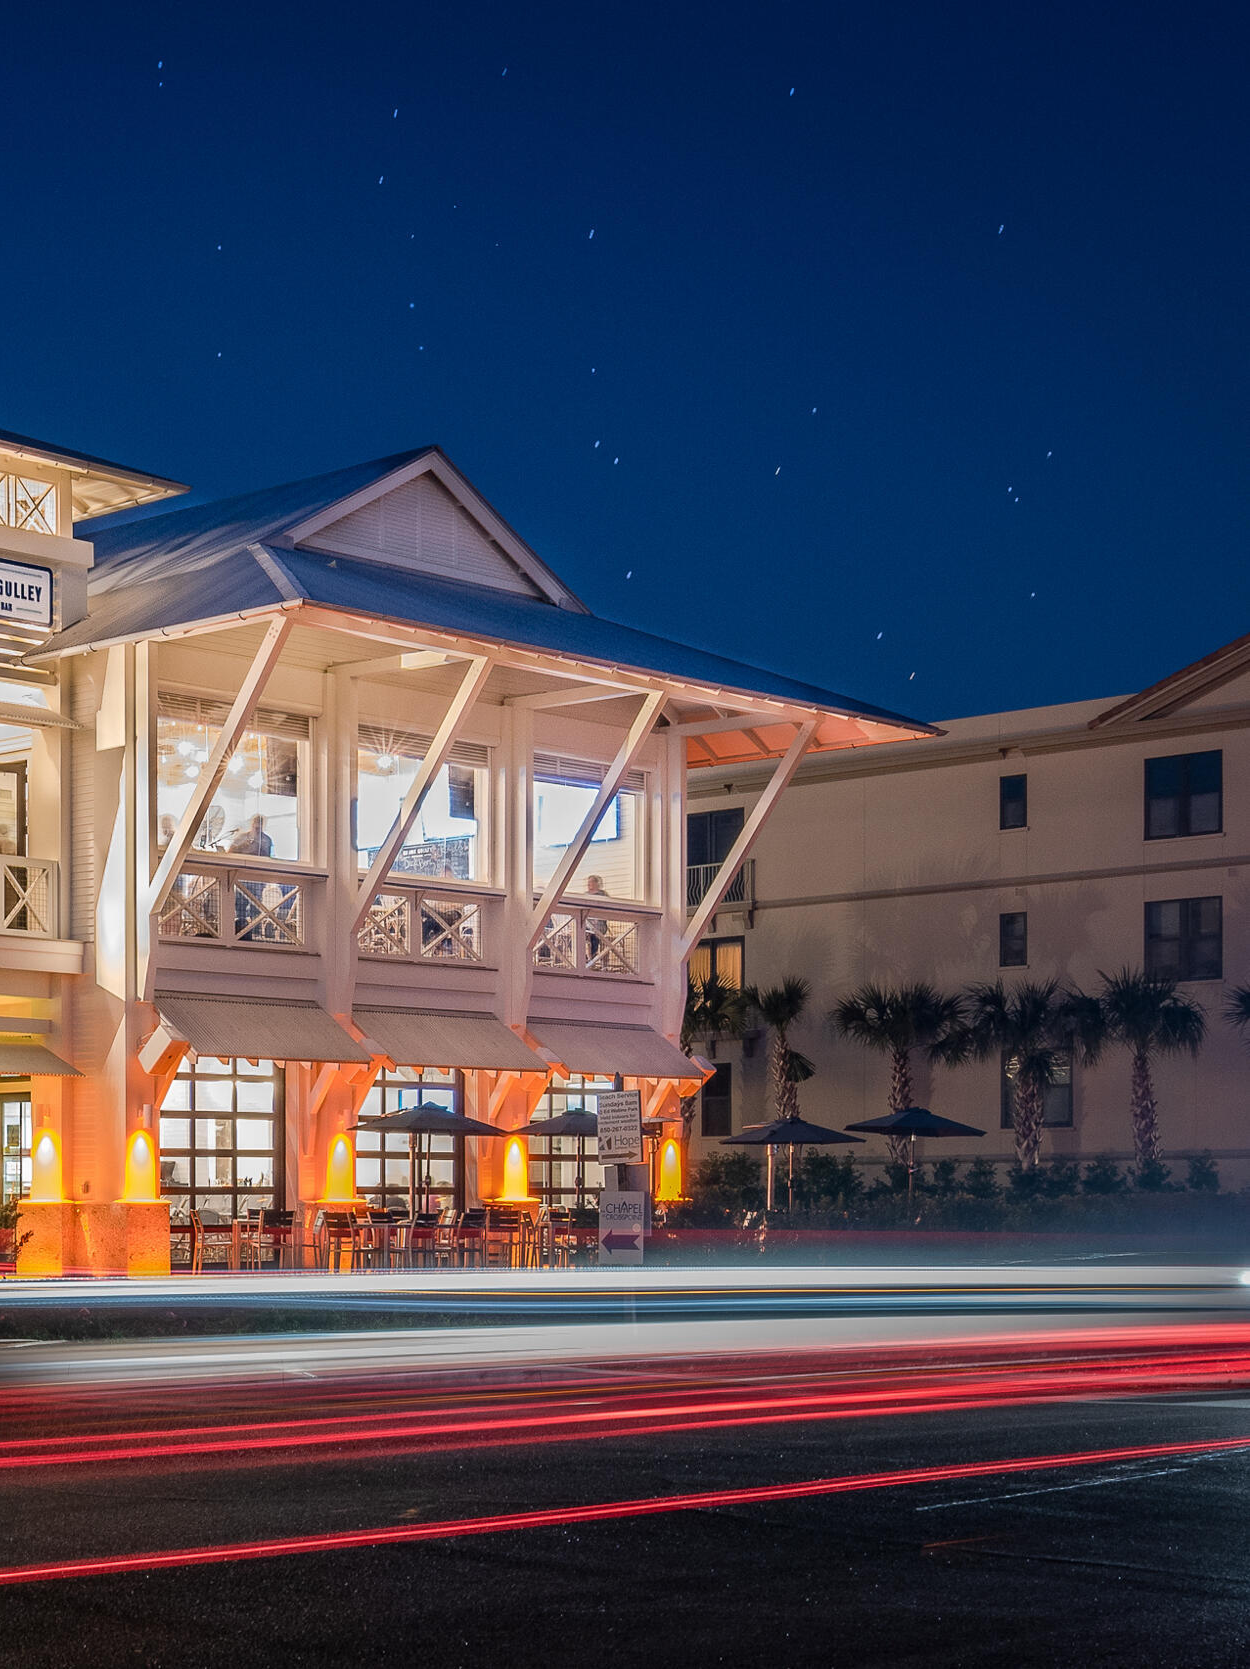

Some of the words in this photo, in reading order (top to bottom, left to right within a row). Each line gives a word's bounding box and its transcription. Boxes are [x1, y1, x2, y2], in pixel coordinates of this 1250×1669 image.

[0, 601, 13, 612] BAR
[614, 1135, 640, 1148] Hope
[605, 1201, 643, 1214] CHAPEL
